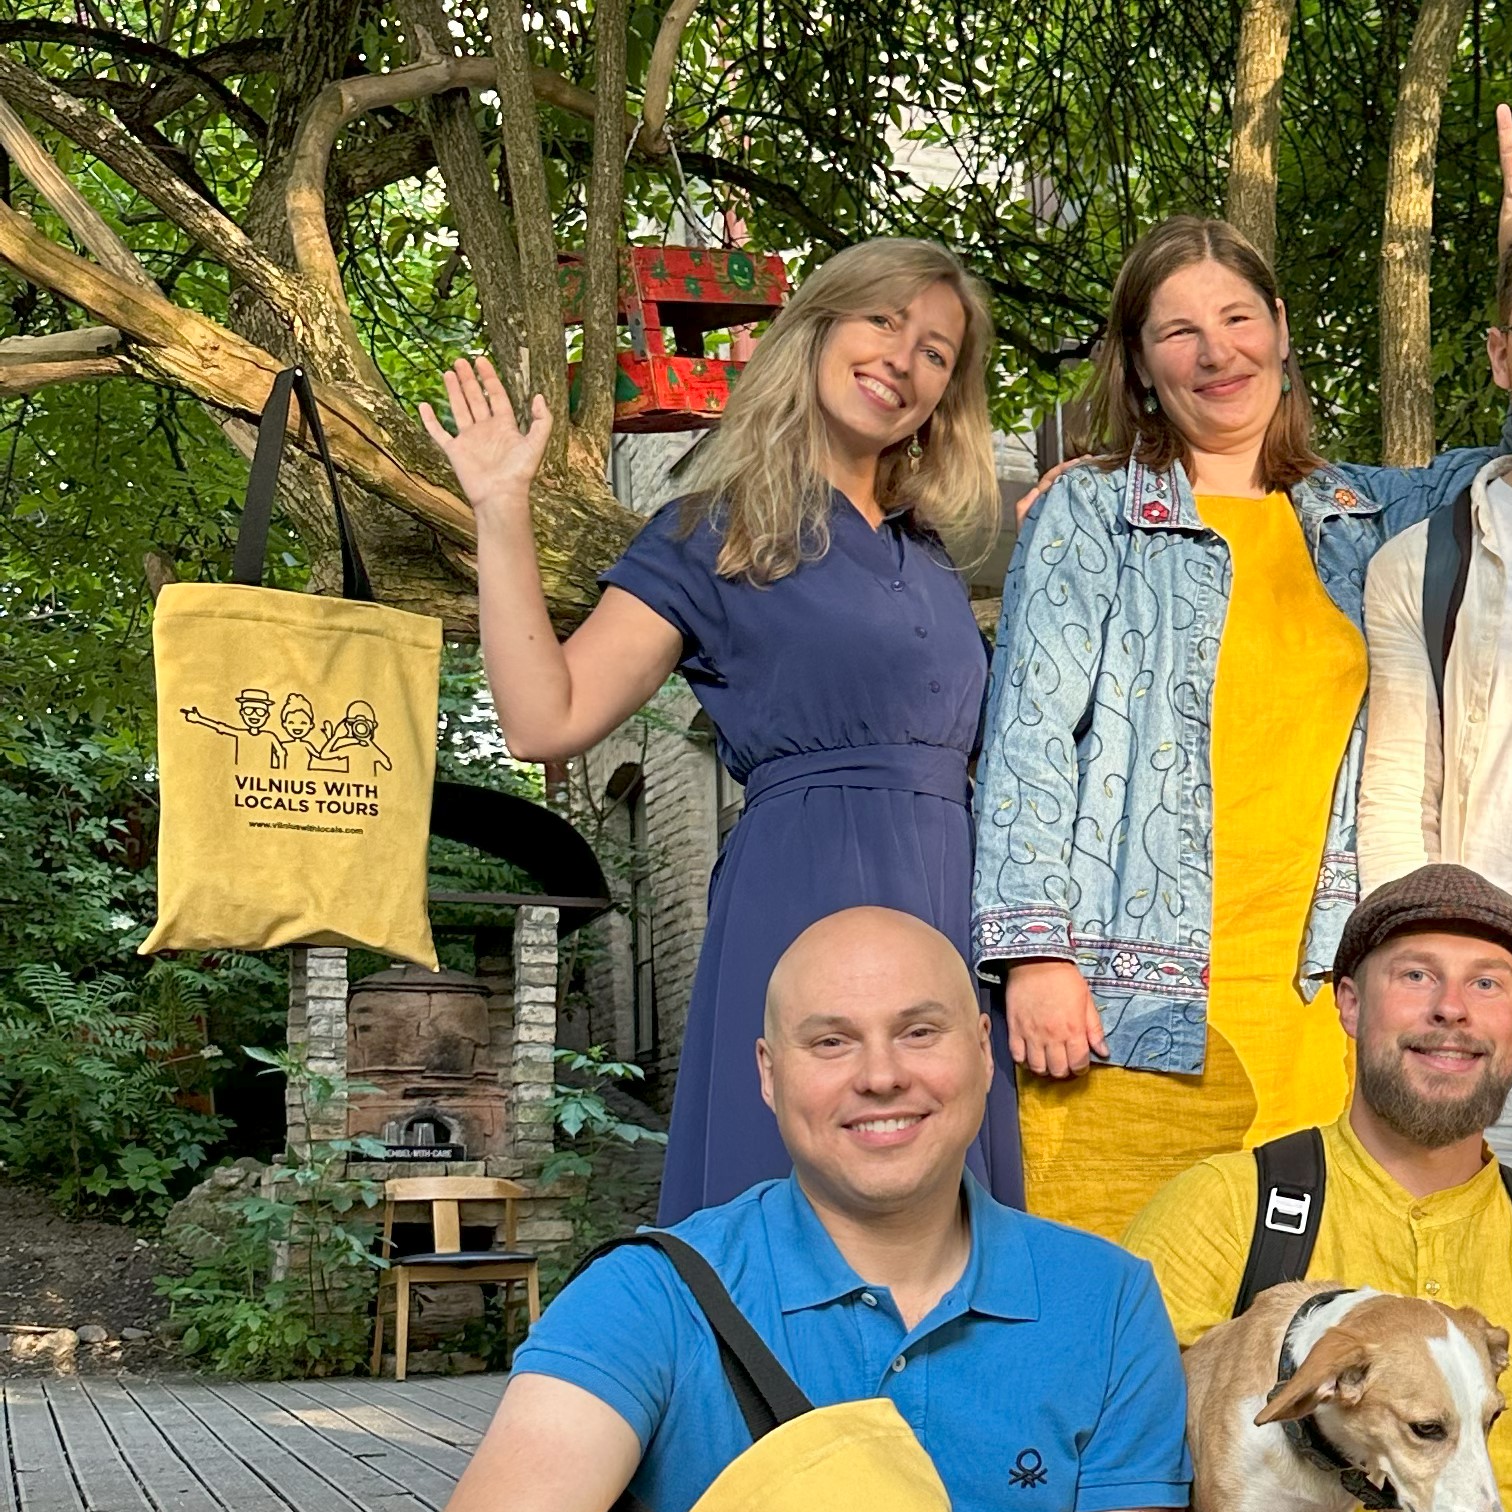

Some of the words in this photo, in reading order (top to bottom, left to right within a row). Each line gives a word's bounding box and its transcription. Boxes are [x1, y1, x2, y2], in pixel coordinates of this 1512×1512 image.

[234, 774, 317, 795] VILNIUS
[323, 780, 379, 799] WITH
[234, 793, 310, 813] LOCALS
[315, 800, 379, 817] TOURS
[248, 820, 364, 835] www.vilniuswithlocals.com
